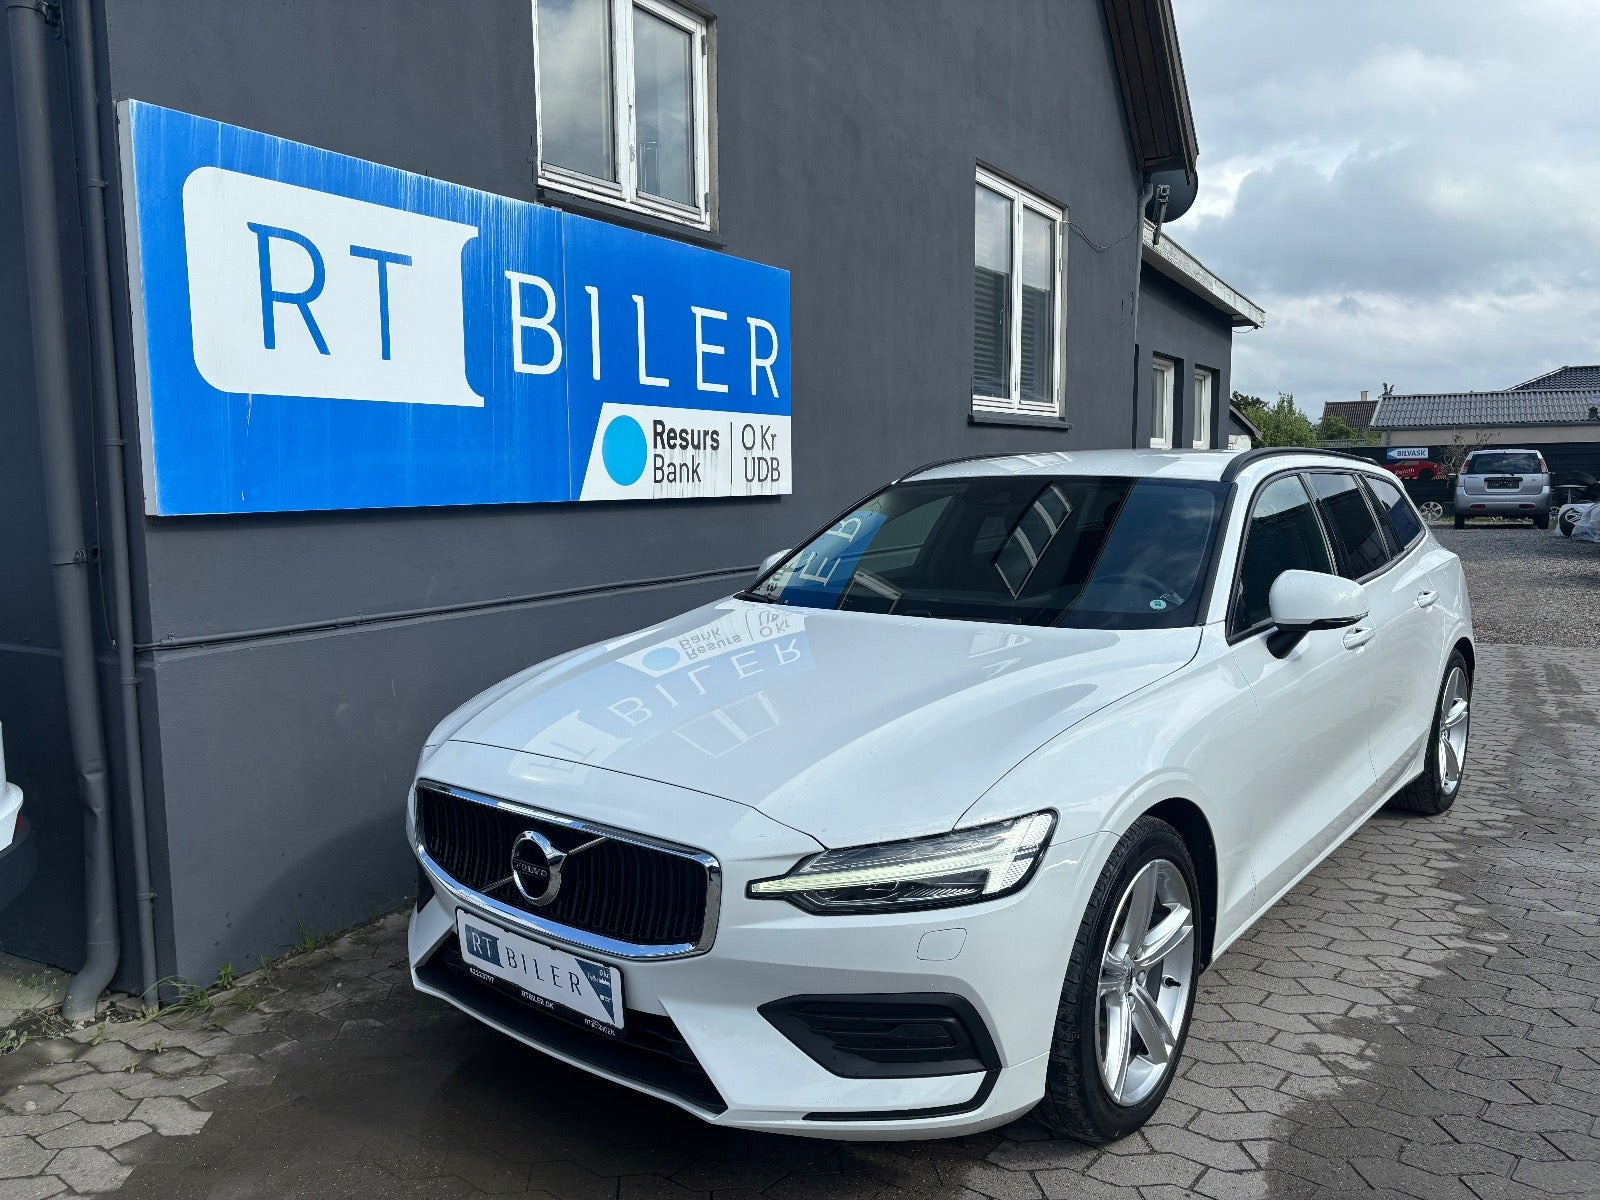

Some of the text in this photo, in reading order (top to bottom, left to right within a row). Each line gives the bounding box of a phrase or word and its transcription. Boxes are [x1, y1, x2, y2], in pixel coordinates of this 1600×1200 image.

[247, 221, 780, 399] RT BILER
[652, 418, 720, 452] Resurs
[760, 425, 777, 451] Kr
[1397, 449, 1426, 457] BILVASK
[652, 453, 702, 484] Bank
[743, 456, 781, 483] UDB
[513, 859, 548, 877] VOLVO
[471, 931, 492, 957] RT
[505, 946, 582, 997] BILER
